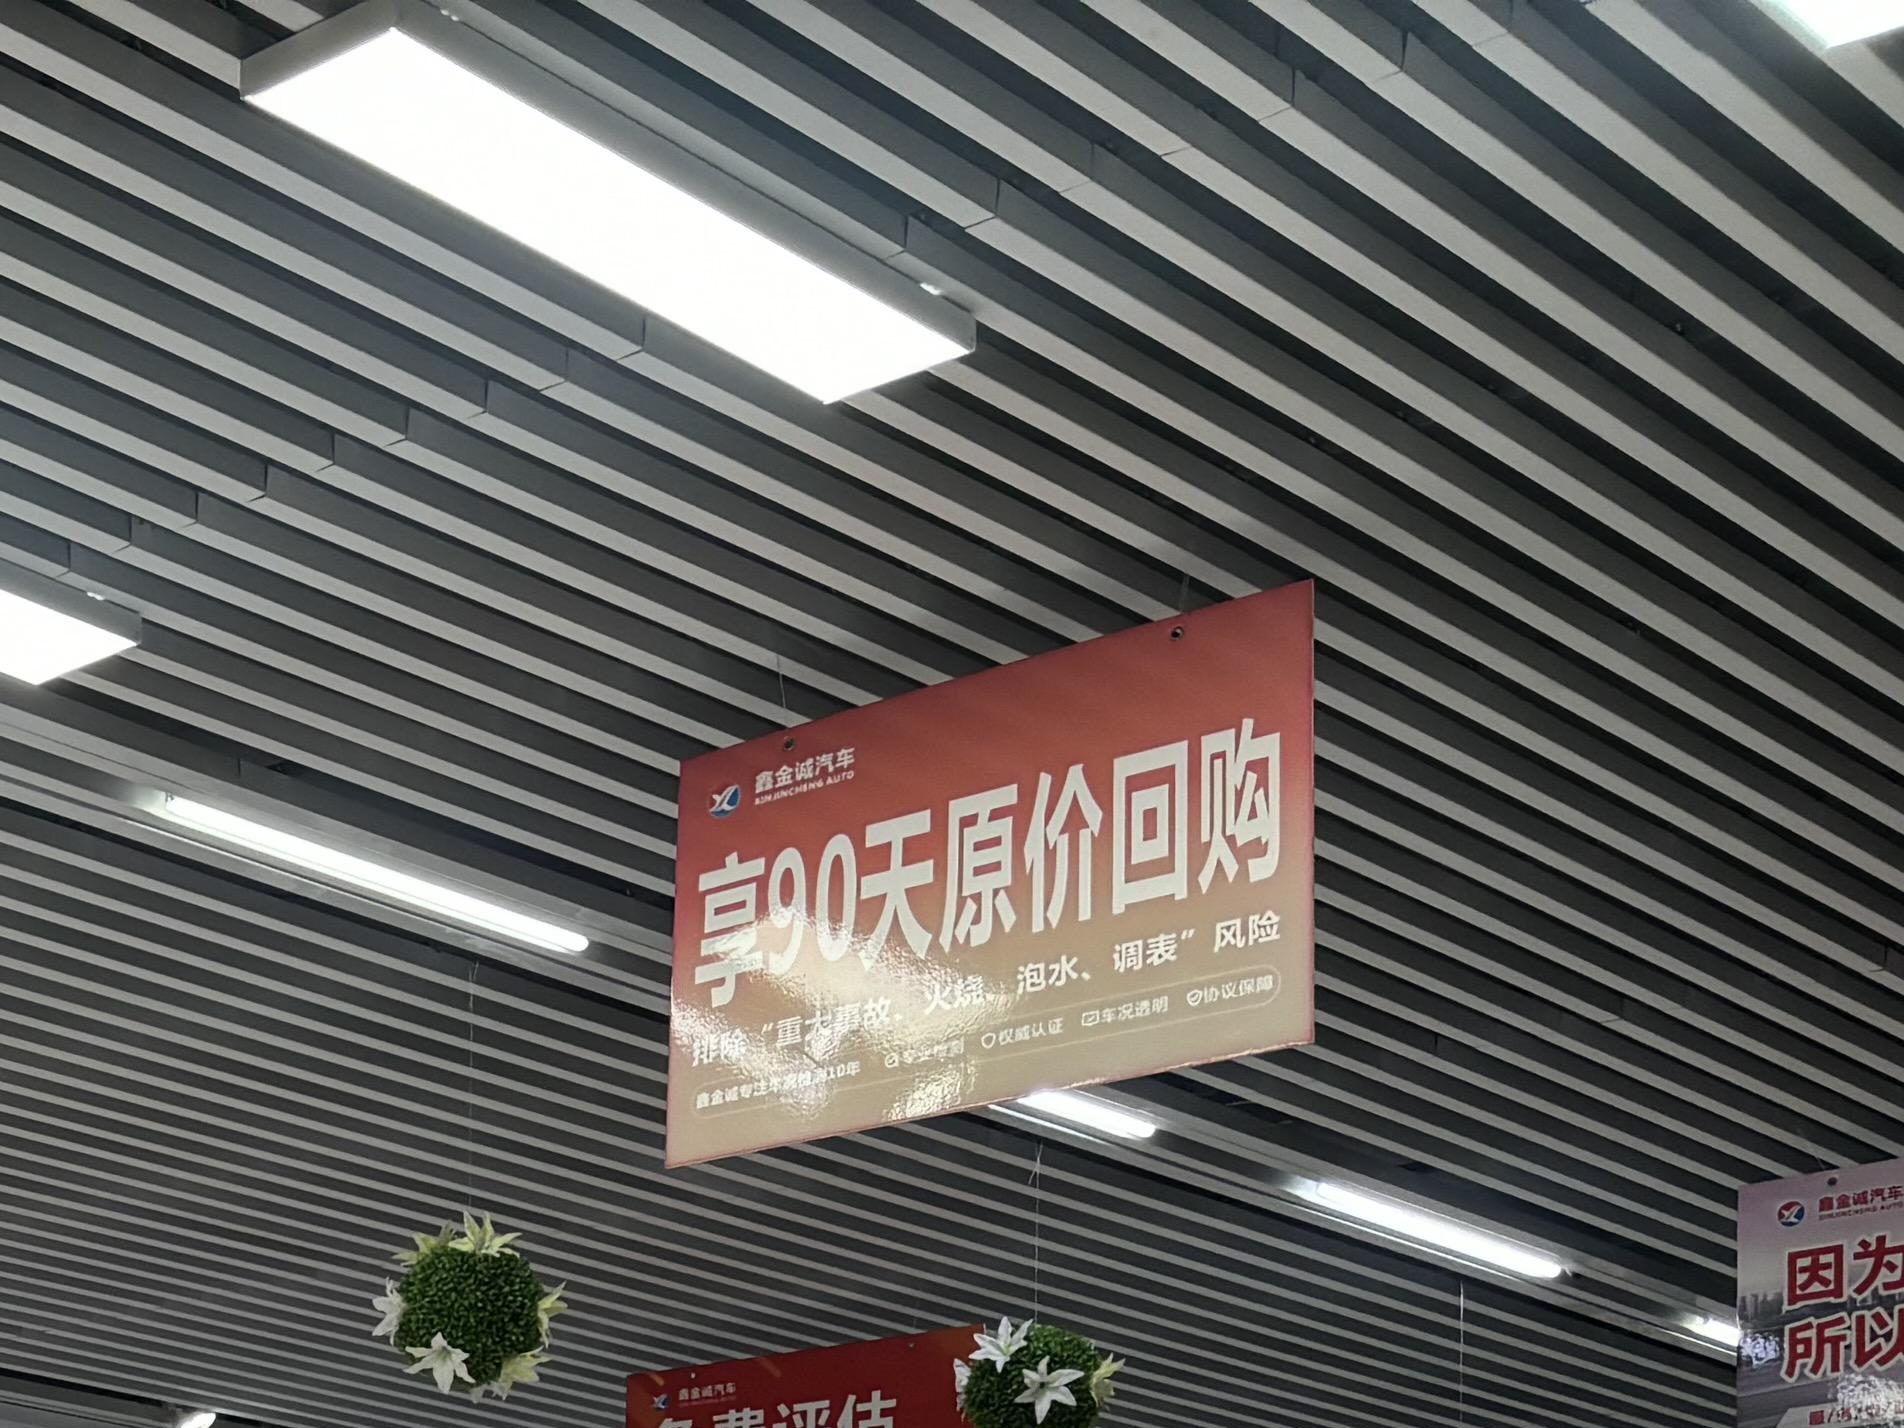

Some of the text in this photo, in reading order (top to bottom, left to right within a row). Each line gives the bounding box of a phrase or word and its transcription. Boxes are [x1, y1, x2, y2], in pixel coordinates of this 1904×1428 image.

[754, 747, 855, 794] 鑫金诚汽车
[826, 770, 855, 786] AUTO
[693, 717, 1282, 1007] 享90天原价回购
[1213, 910, 1282, 952] 风险
[999, 1018, 1064, 1046] 权威认证
[1101, 996, 1169, 1025] 车况透明
[1204, 974, 1275, 1004] 协议保障
[1786, 1234, 1904, 1308] 因为
[1784, 1307, 1904, 1380] 所以
